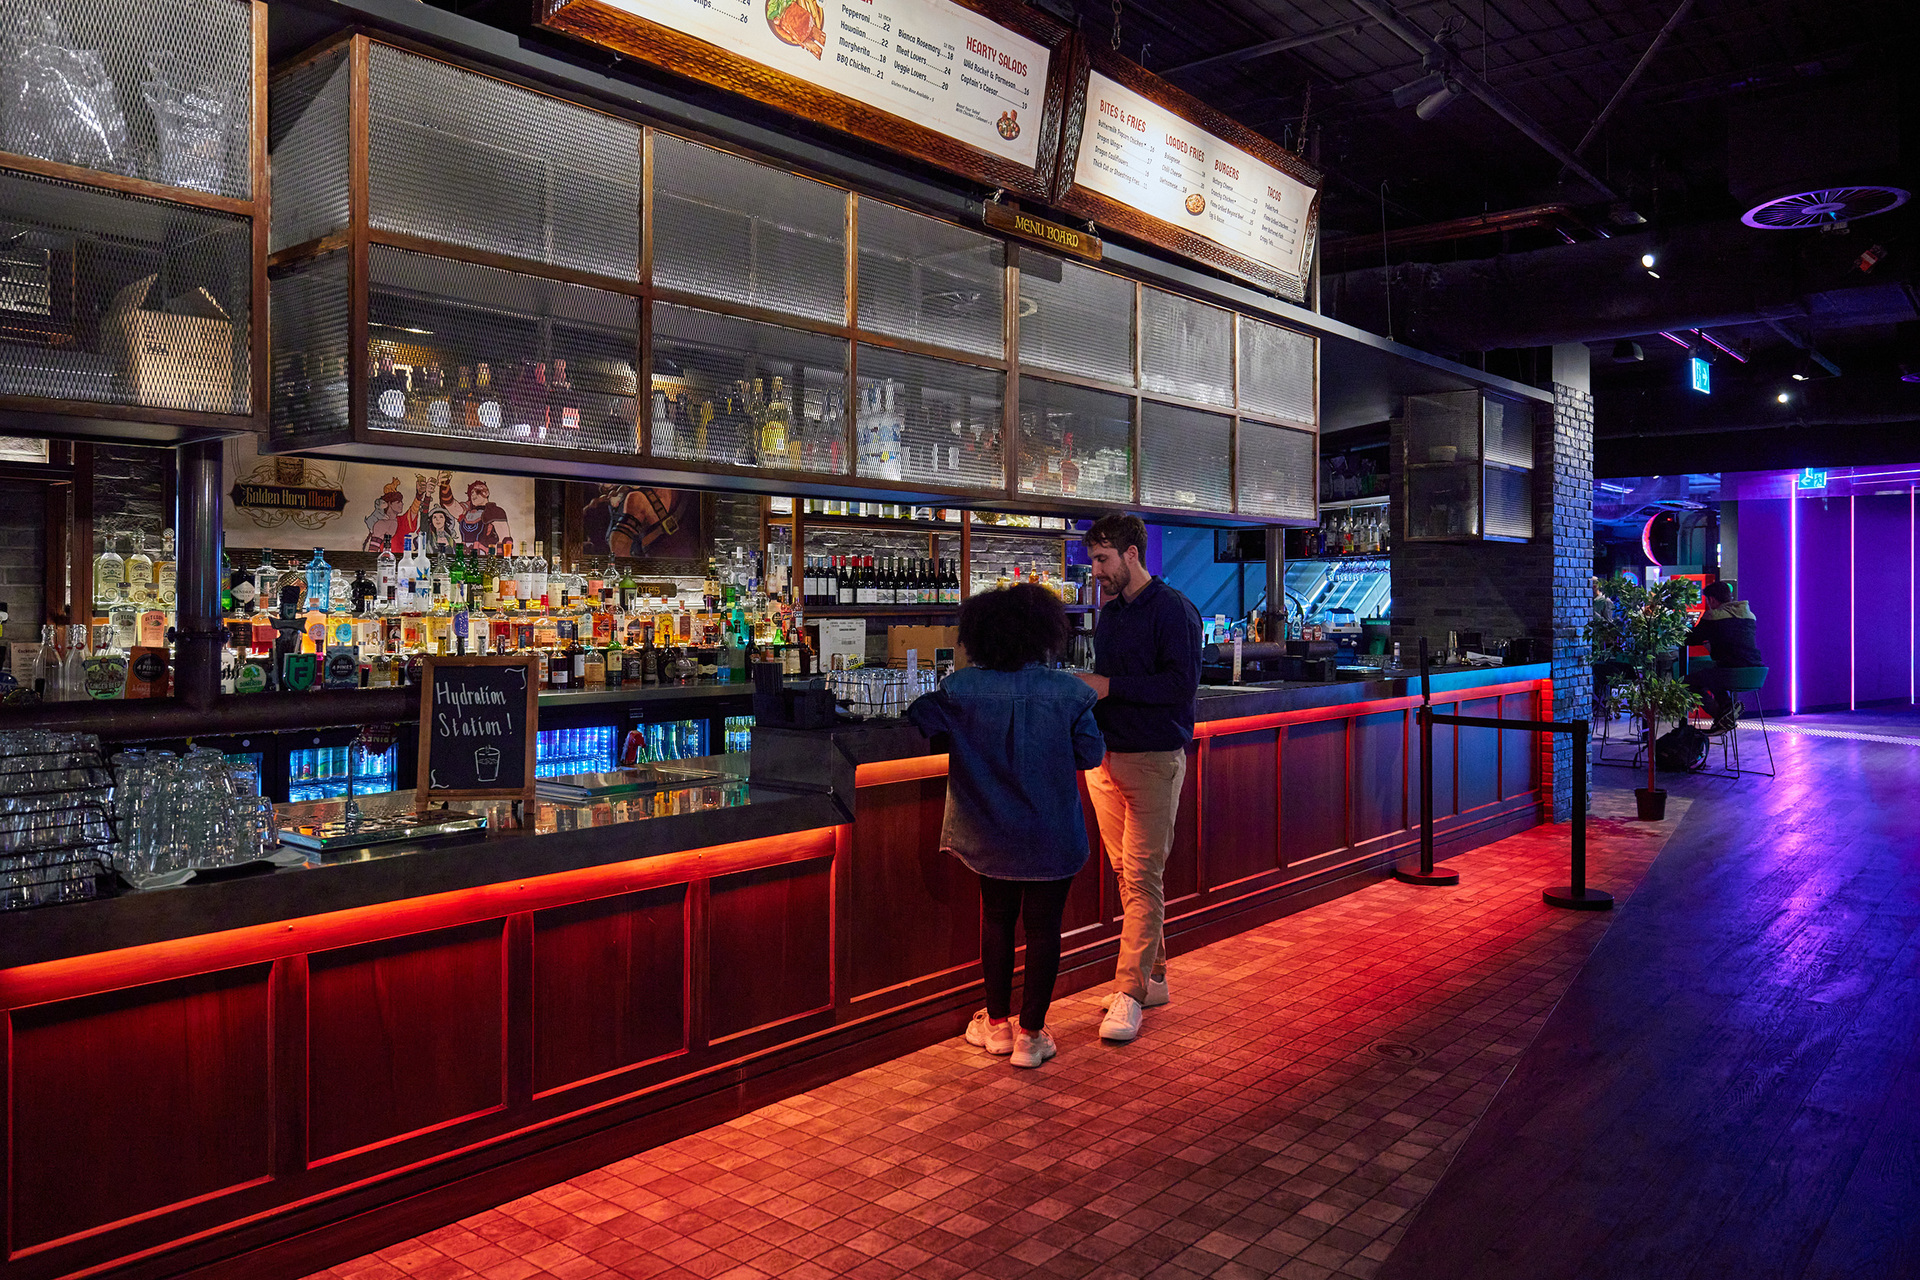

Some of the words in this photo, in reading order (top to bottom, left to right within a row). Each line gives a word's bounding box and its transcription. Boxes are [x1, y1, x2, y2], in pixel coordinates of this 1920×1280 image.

[740, 13, 748, 24] 26
[842, 4, 870, 22] Pepperoni
[882, 22, 890, 32] 22
[840, 20, 866, 38] Hawaiian
[881, 38, 889, 48] 22
[898, 29, 915, 43] Bianca
[916, 37, 940, 57] Rosemary
[839, 37, 870, 57] Margherita
[880, 54, 886, 64] 18
[896, 45, 910, 57] Meat
[910, 51, 927, 65] Lovers
[944, 67, 951, 76] 24
[966, 36, 997, 62] HEARTY
[998, 52, 1028, 77] SALADS
[836, 53, 848, 67] BBQ
[849, 58, 871, 74] Chicken
[876, 70, 884, 80] 21
[894, 60, 910, 75] Veggie
[911, 67, 927, 81] Lovers
[941, 82, 948, 90] 20
[963, 59, 974, 70] Wild
[974, 63, 989, 77] Rocket
[990, 71, 994, 79] &
[961, 74, 982, 90] Captain's
[983, 84, 998, 96] Caesar
[1100, 100, 1118, 119] BITES
[1120, 110, 1125, 123] &
[1127, 114, 1146, 132] FRIES
[1097, 132, 1109, 144] Dragon
[1098, 119, 1117, 134] Buttermilk
[1117, 128, 1129, 141] Popcorn
[1095, 146, 1108, 157] Dragon
[1166, 134, 1188, 154] LOADED
[1189, 146, 1205, 163] FRIES
[1093, 158, 1103, 169] Thick
[1214, 159, 1240, 180] BURGERS
[1267, 186, 1282, 202] TACOS
[1015, 215, 1044, 237] MENU
[1046, 226, 1079, 248] BOARD
[245, 487, 280, 505] Golden
[282, 489, 307, 508] Horn
[308, 491, 337, 508] Mead
[436, 682, 507, 718] Hydration
